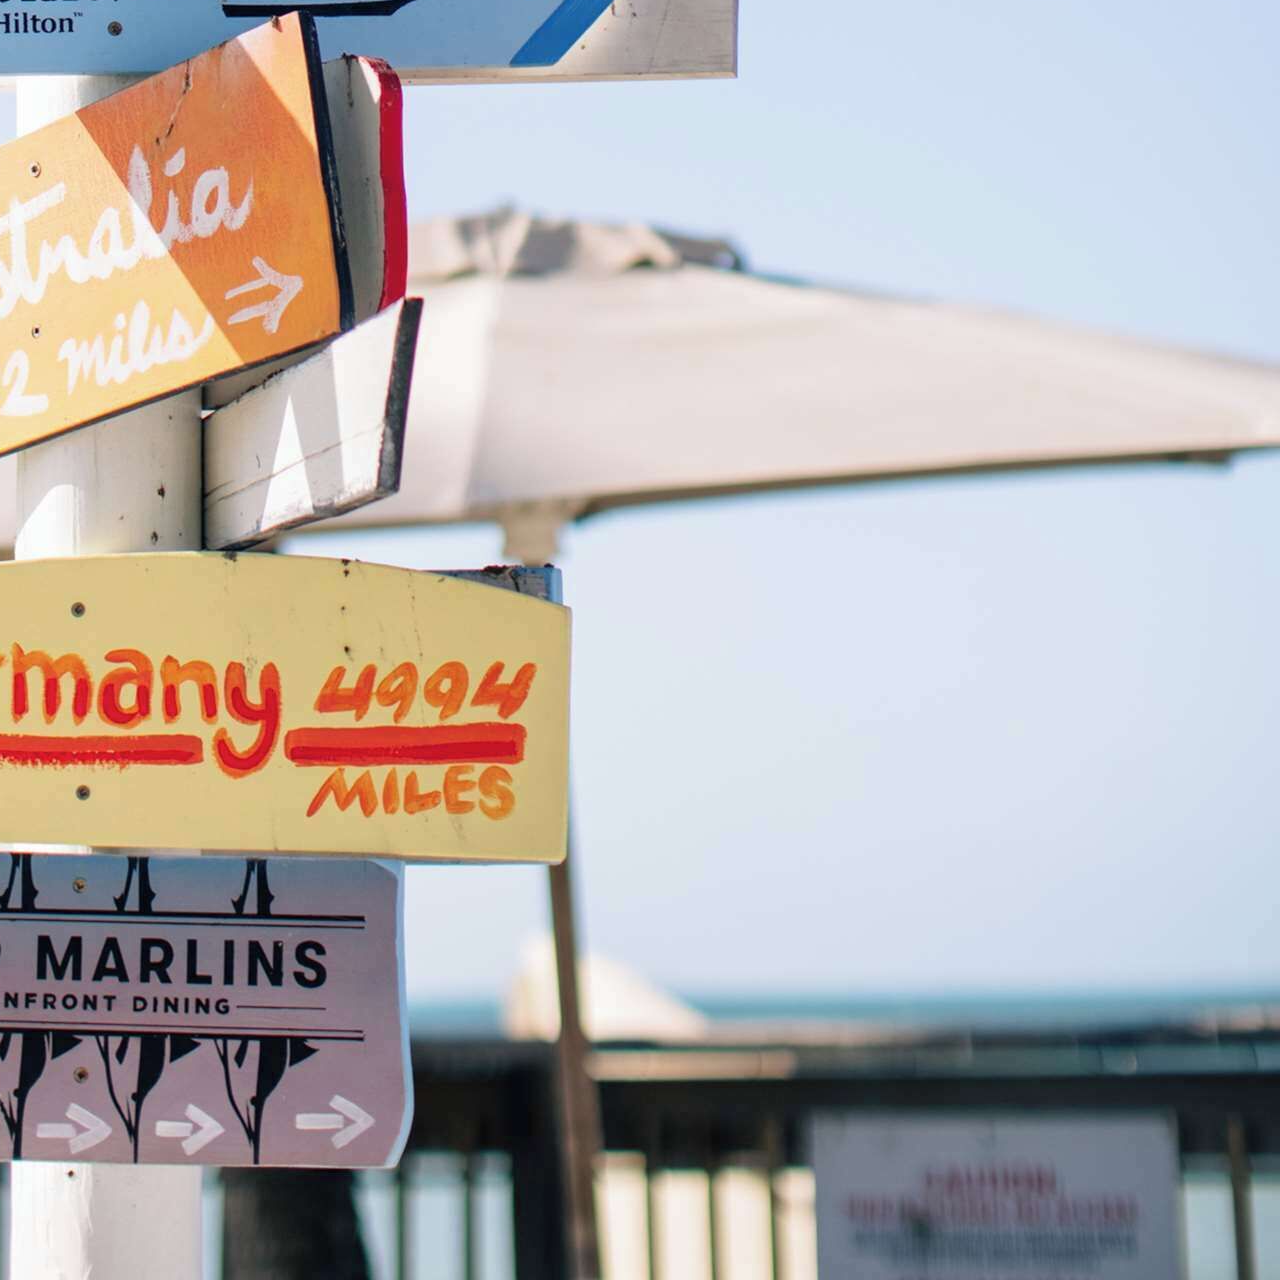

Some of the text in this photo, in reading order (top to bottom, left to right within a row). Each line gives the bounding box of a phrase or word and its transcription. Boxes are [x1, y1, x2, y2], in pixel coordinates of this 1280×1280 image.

[57, 298, 216, 397] miles
[313, 660, 538, 724] 4994
[305, 764, 516, 821] MILES
[35, 933, 329, 990] MARLINS
[132, 995, 231, 1016] DINING
